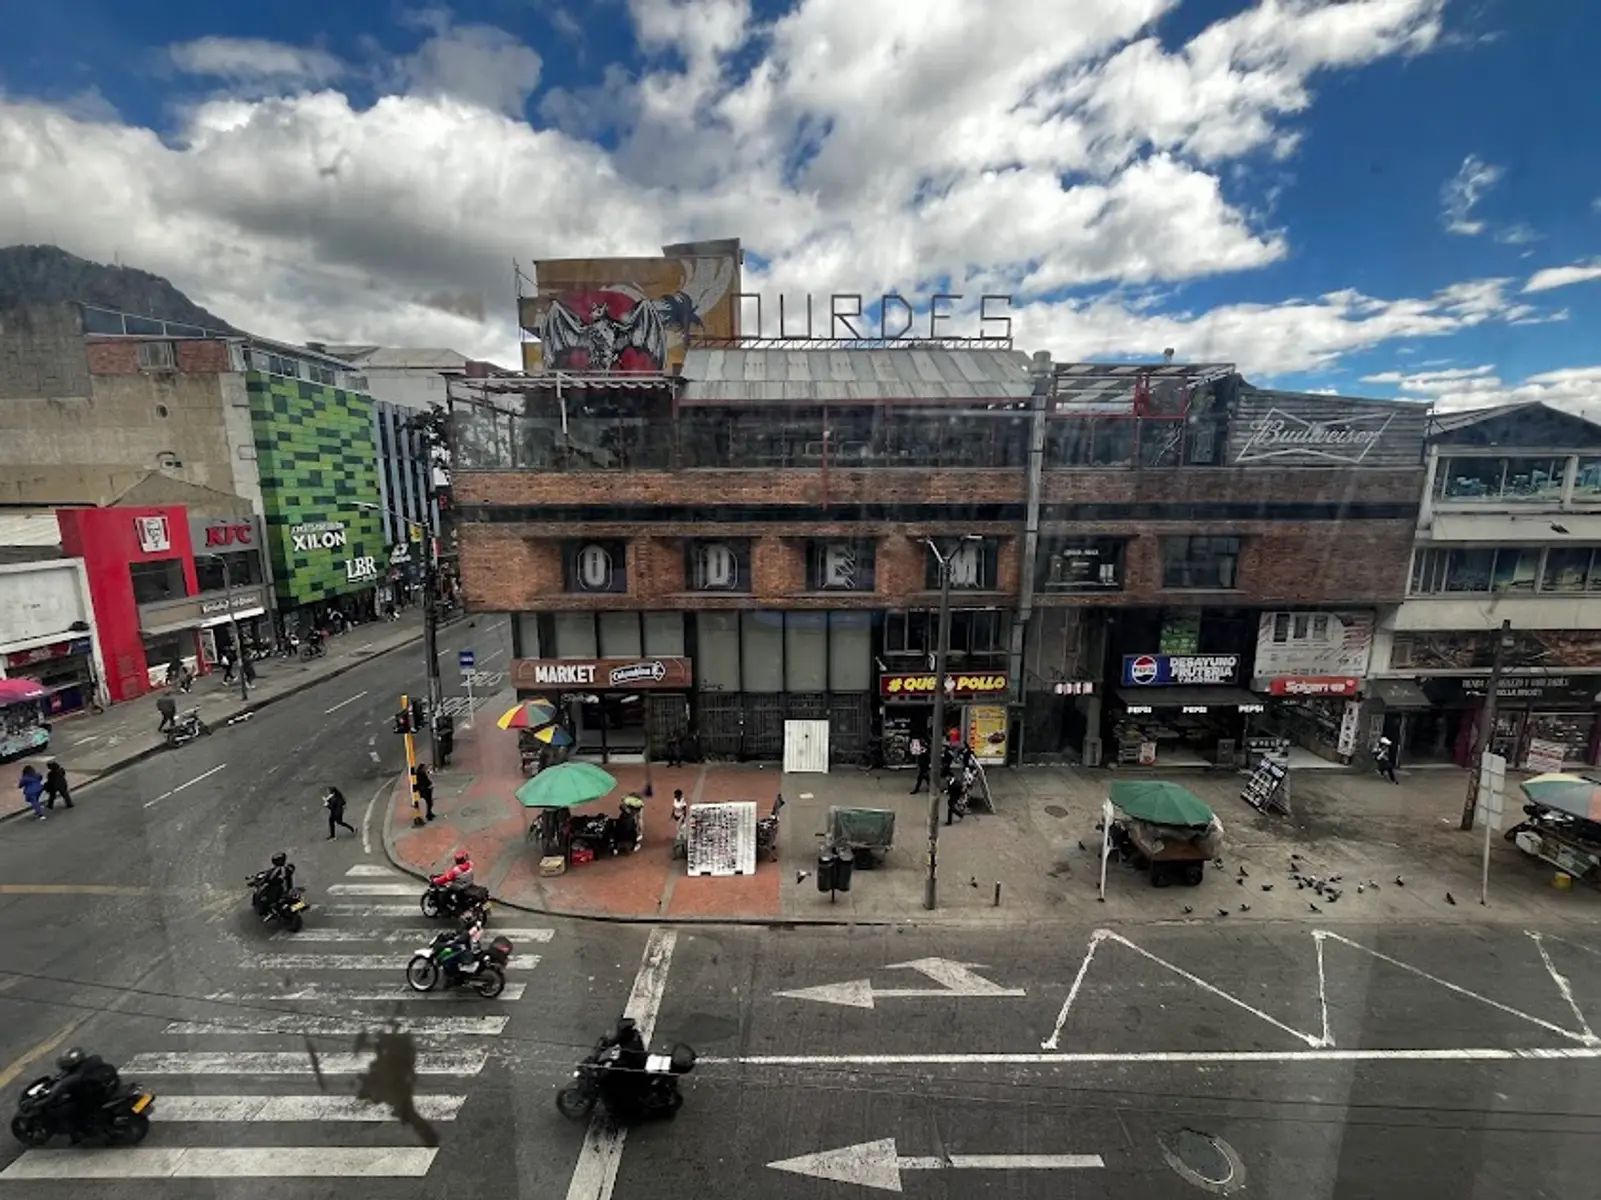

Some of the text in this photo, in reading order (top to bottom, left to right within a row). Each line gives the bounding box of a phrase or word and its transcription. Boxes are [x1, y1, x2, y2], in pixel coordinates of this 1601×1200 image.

[1249, 419, 1381, 447] Budweiser
[205, 524, 252, 547] KFC
[291, 530, 347, 552] XILON
[345, 555, 377, 579] LBR
[535, 664, 596, 683] MARKET
[956, 676, 1006, 690] POLLO
